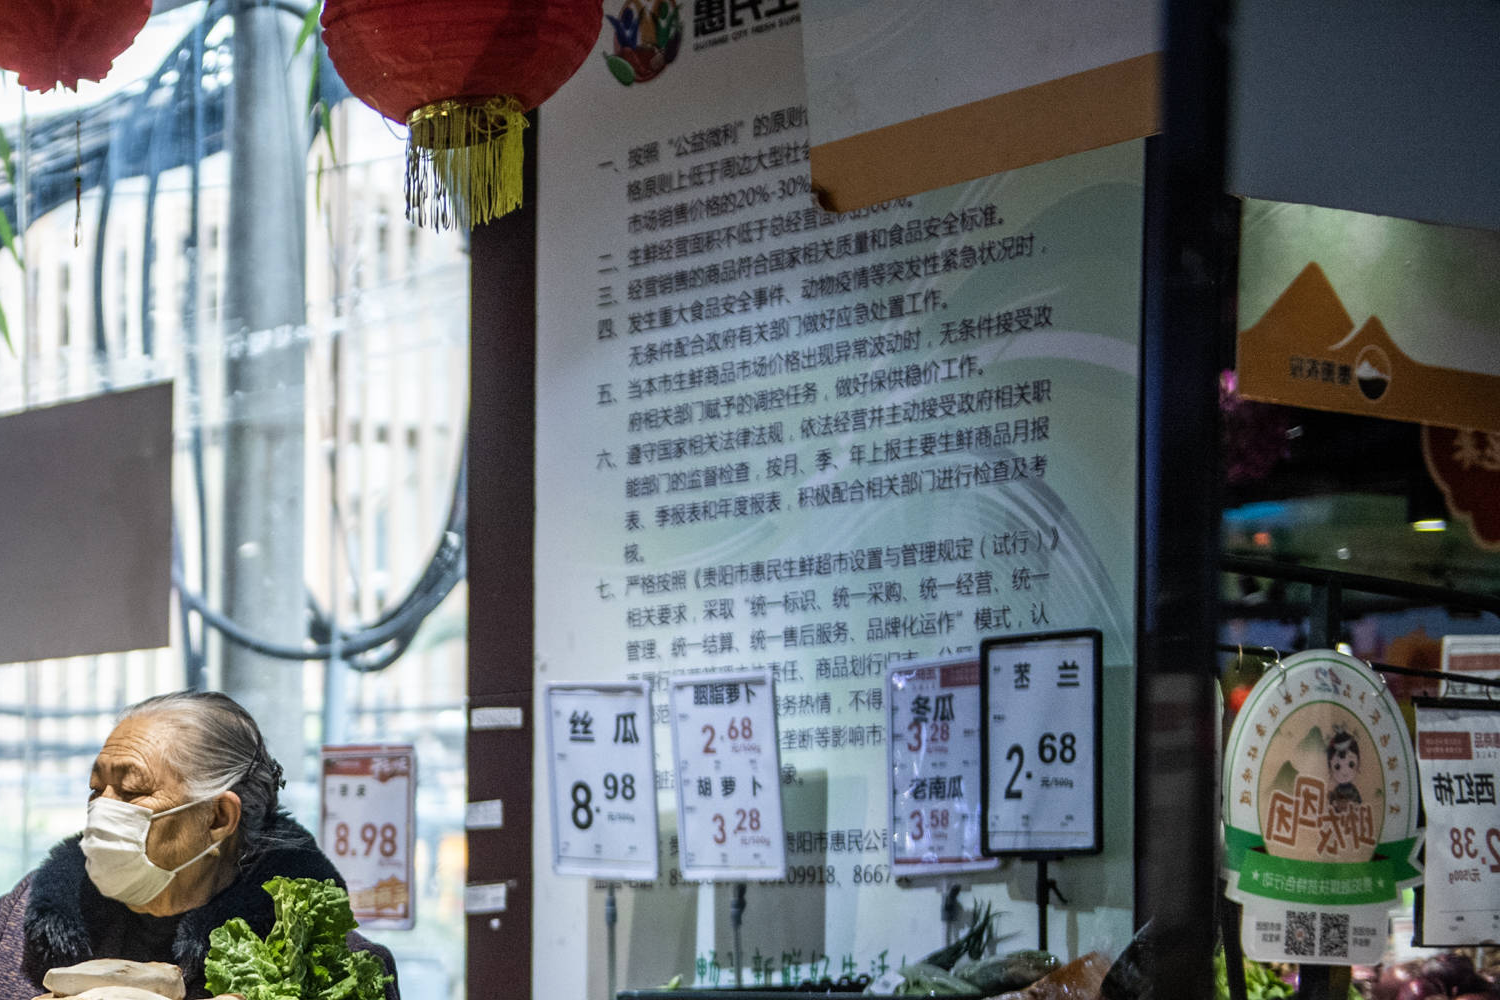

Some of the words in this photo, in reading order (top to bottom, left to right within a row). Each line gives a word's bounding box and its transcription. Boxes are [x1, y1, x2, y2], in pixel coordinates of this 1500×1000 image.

[910, 693, 955, 722] 冬瓜
[569, 710, 639, 743] 丝瓜
[701, 717, 753, 754] 2.68
[907, 721, 950, 752] 3.28
[1004, 732, 1077, 800] 2.68
[571, 772, 636, 830] 8.98
[696, 775, 762, 798] 胡萝卜
[334, 822, 398, 858] 8.98
[712, 806, 761, 845] 3.28
[910, 808, 950, 841] 3.58
